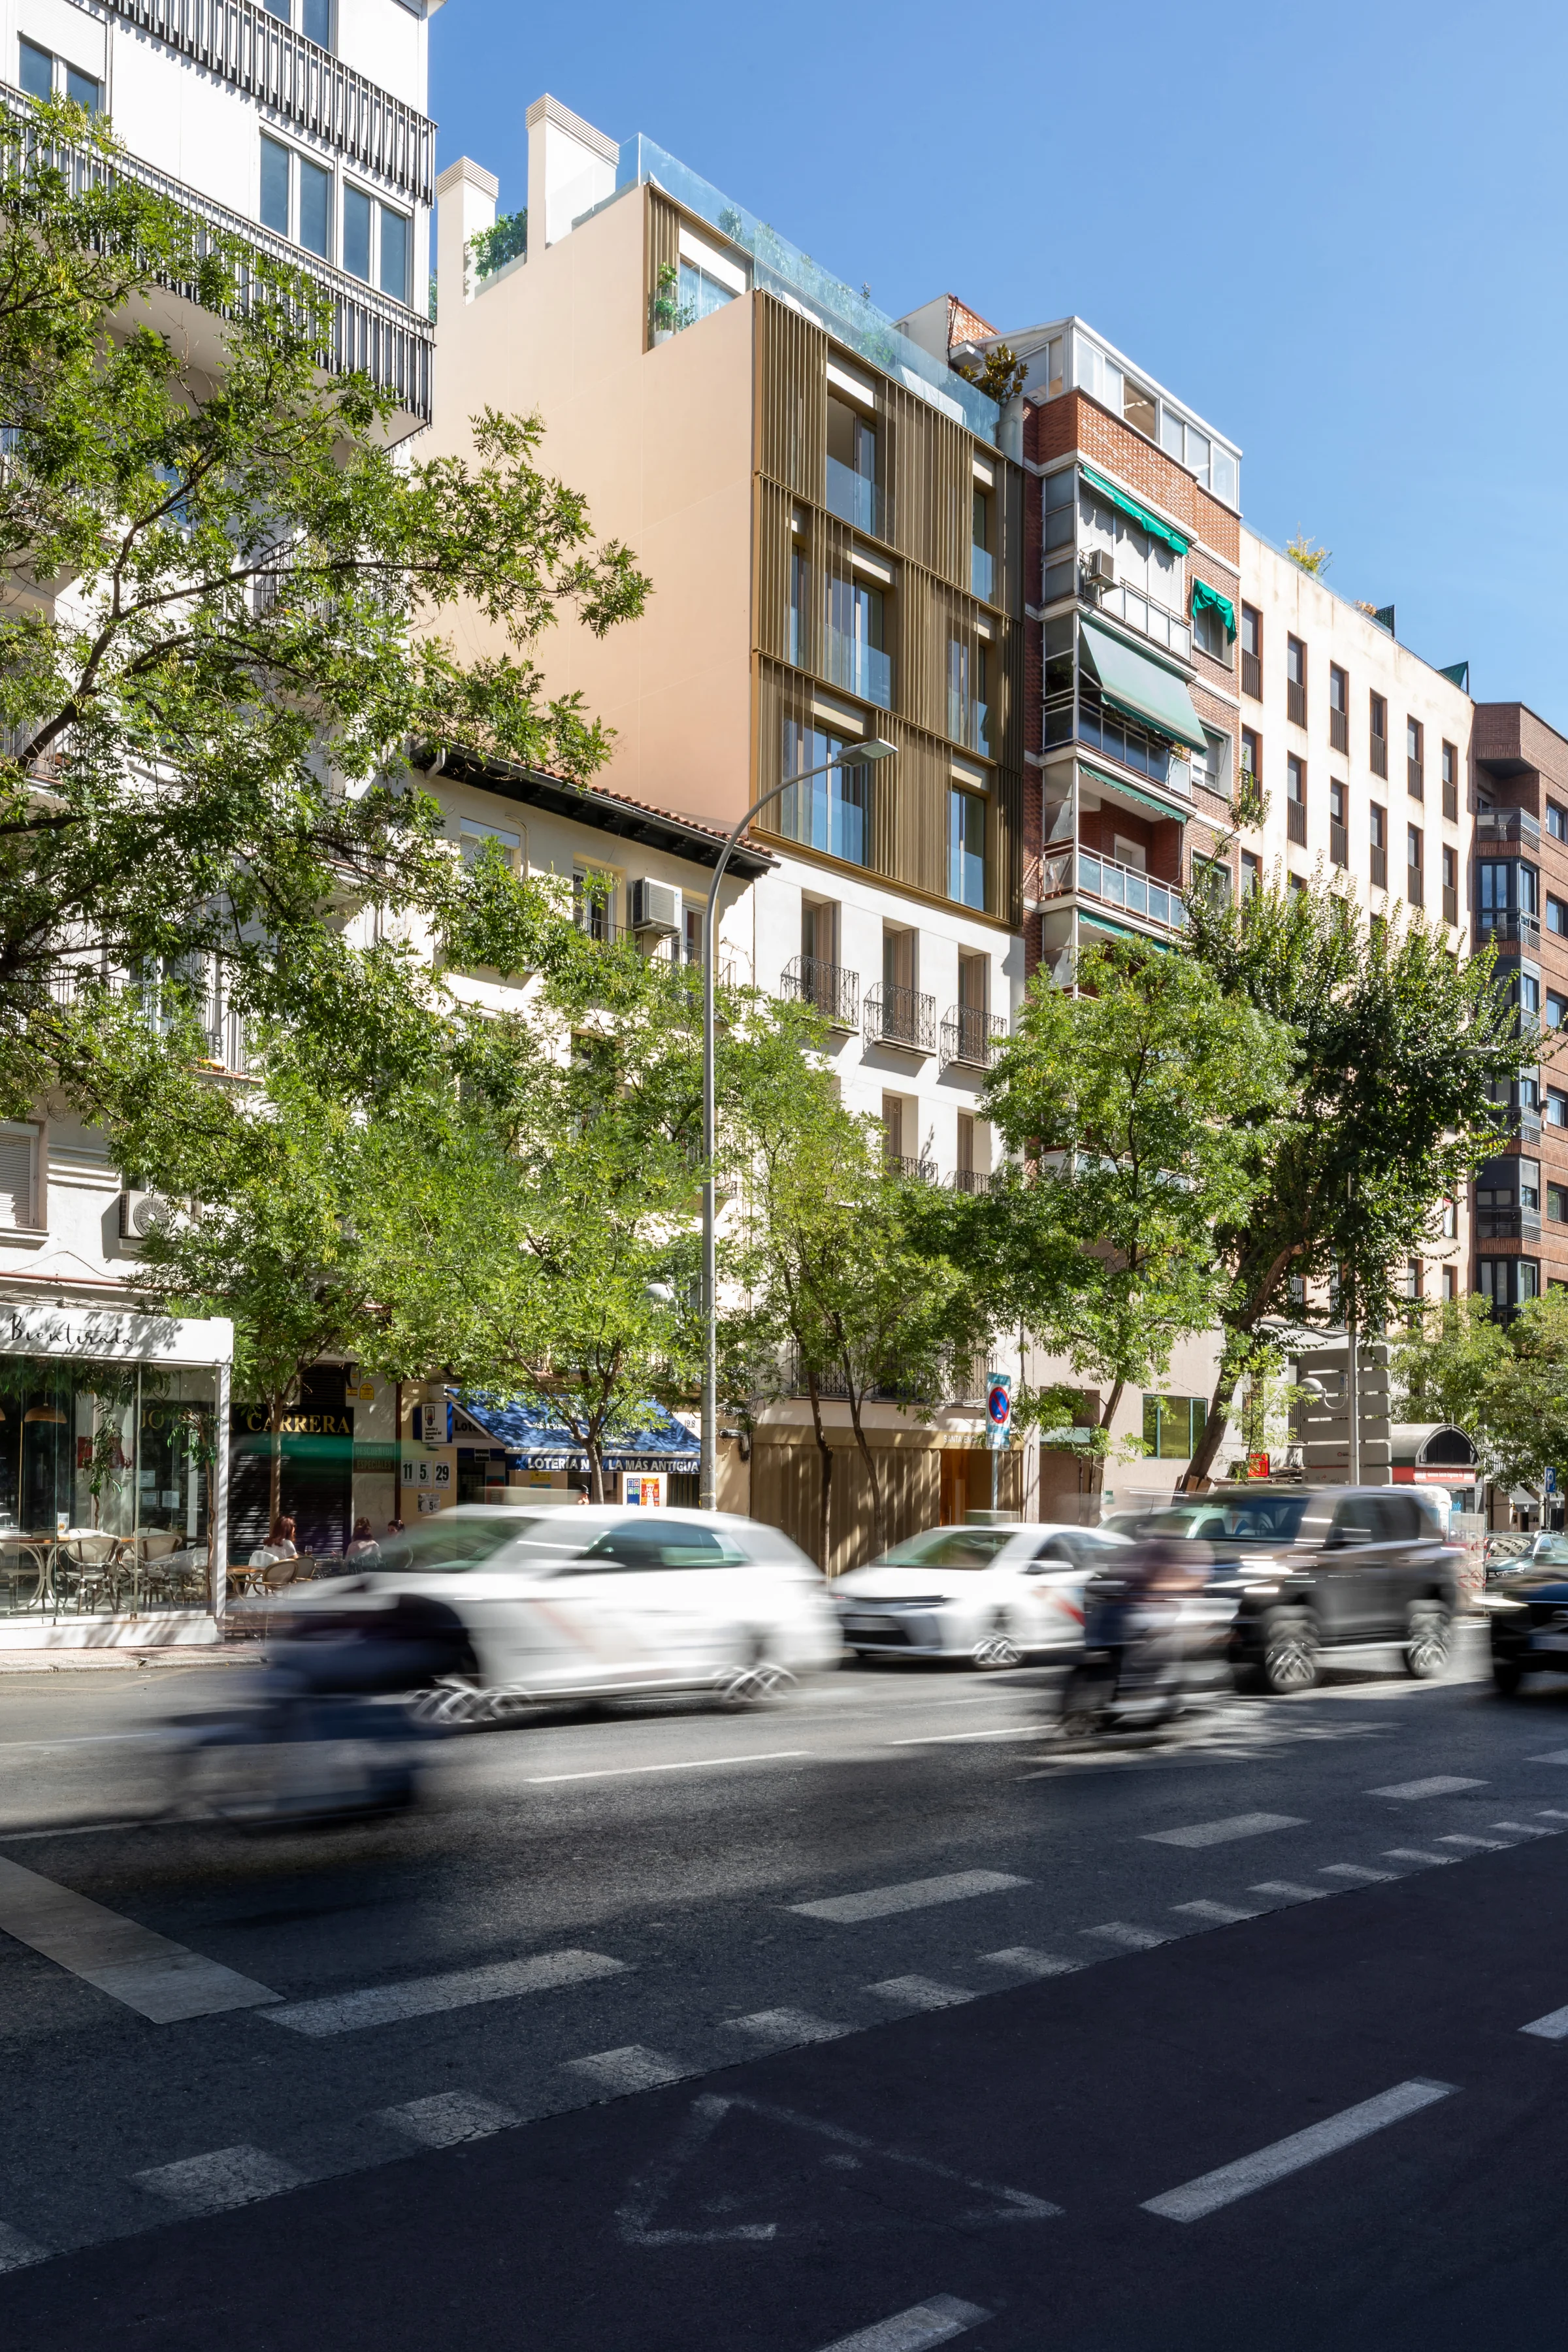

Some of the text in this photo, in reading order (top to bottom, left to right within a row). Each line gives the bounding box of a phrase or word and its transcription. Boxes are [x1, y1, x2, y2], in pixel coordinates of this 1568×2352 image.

[8, 1313, 135, 1345] Bientirada
[455, 1420, 481, 1432] Lote
[943, 1435, 962, 1443] SANTA
[355, 1446, 393, 1456] DESCUENTOS
[357, 1460, 391, 1469] ESPECIALES
[403, 1463, 412, 1479] 11
[528, 1456, 579, 1469] LOTERÍA
[608, 1459, 623, 1470] LA
[625, 1458, 648, 1471] MÁS
[650, 1460, 699, 1472] ANTIGUA
[436, 1465, 449, 1481] 29
